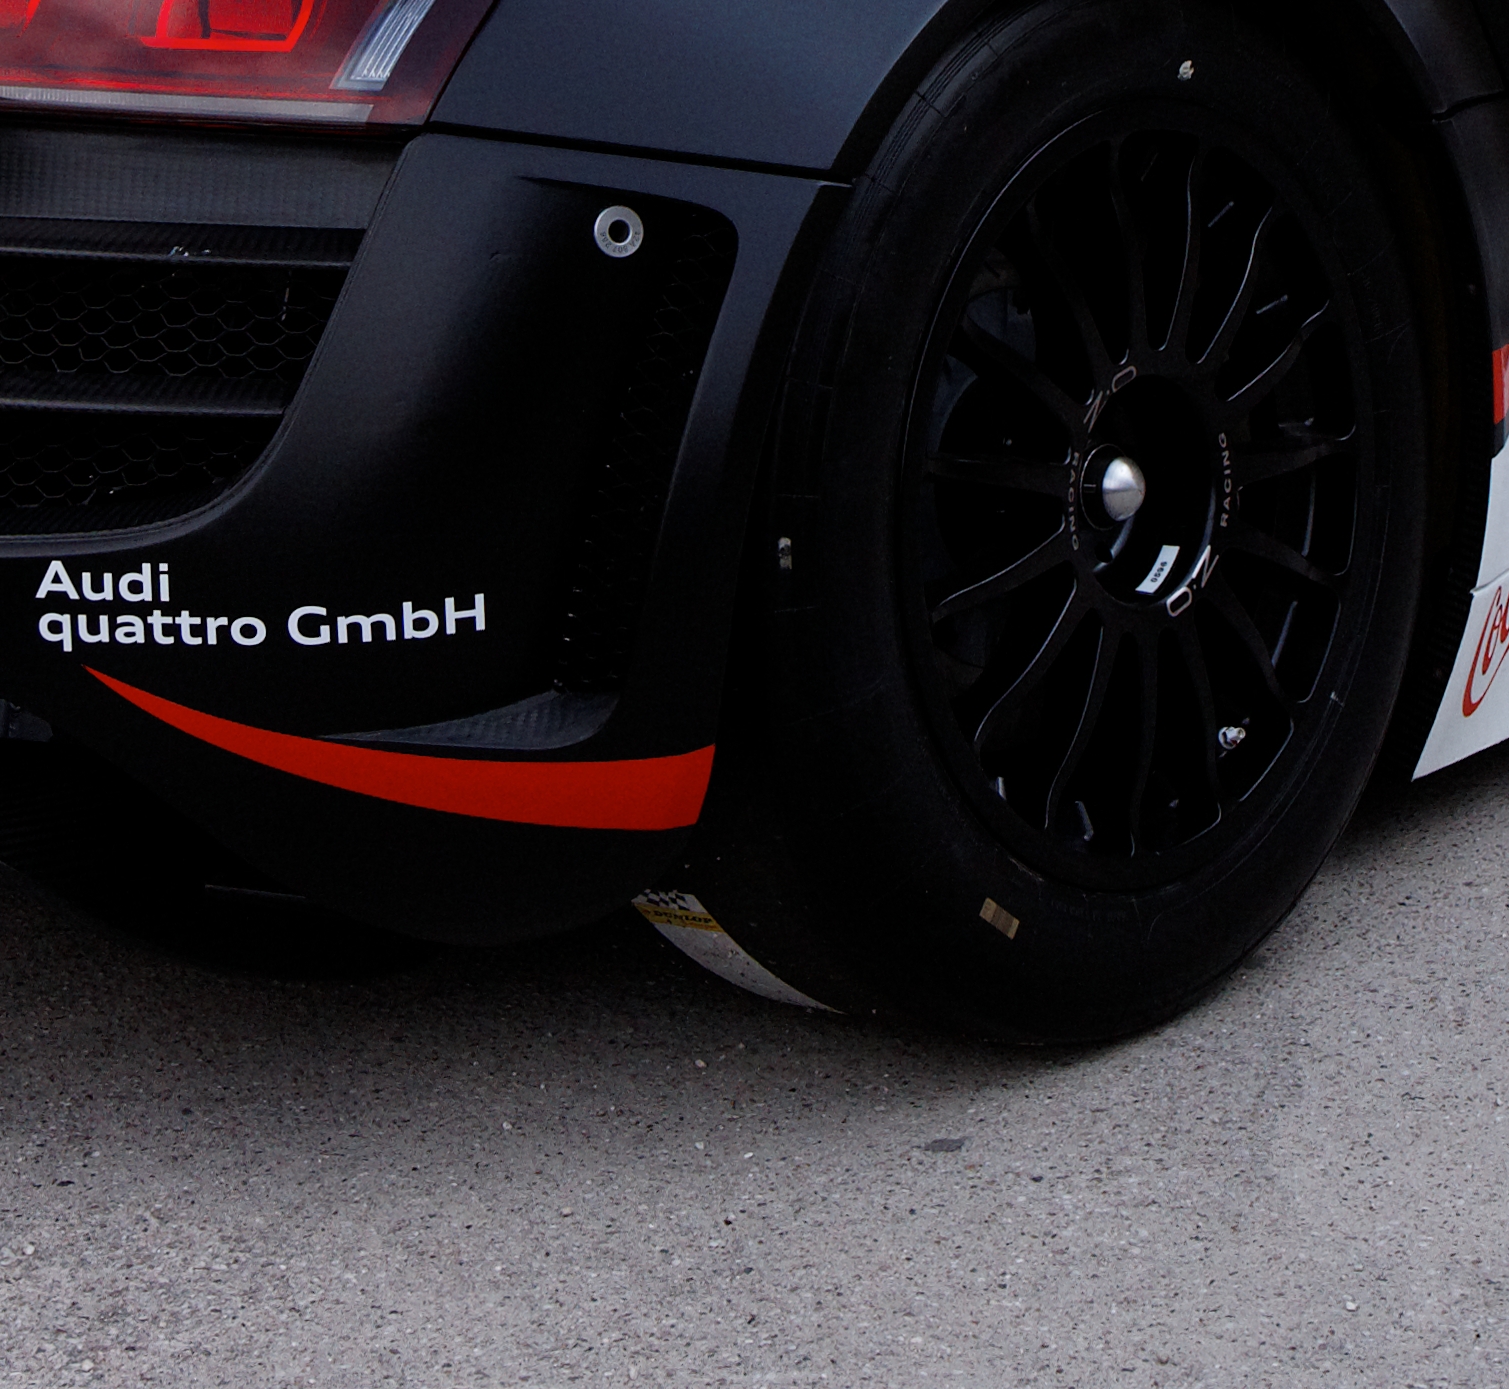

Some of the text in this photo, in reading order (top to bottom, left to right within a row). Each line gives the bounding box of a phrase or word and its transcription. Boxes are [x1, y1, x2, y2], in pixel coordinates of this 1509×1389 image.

[1218, 432, 1233, 528] RACING
[35, 559, 170, 602] Audi
[38, 593, 486, 653] quattro GmbH
